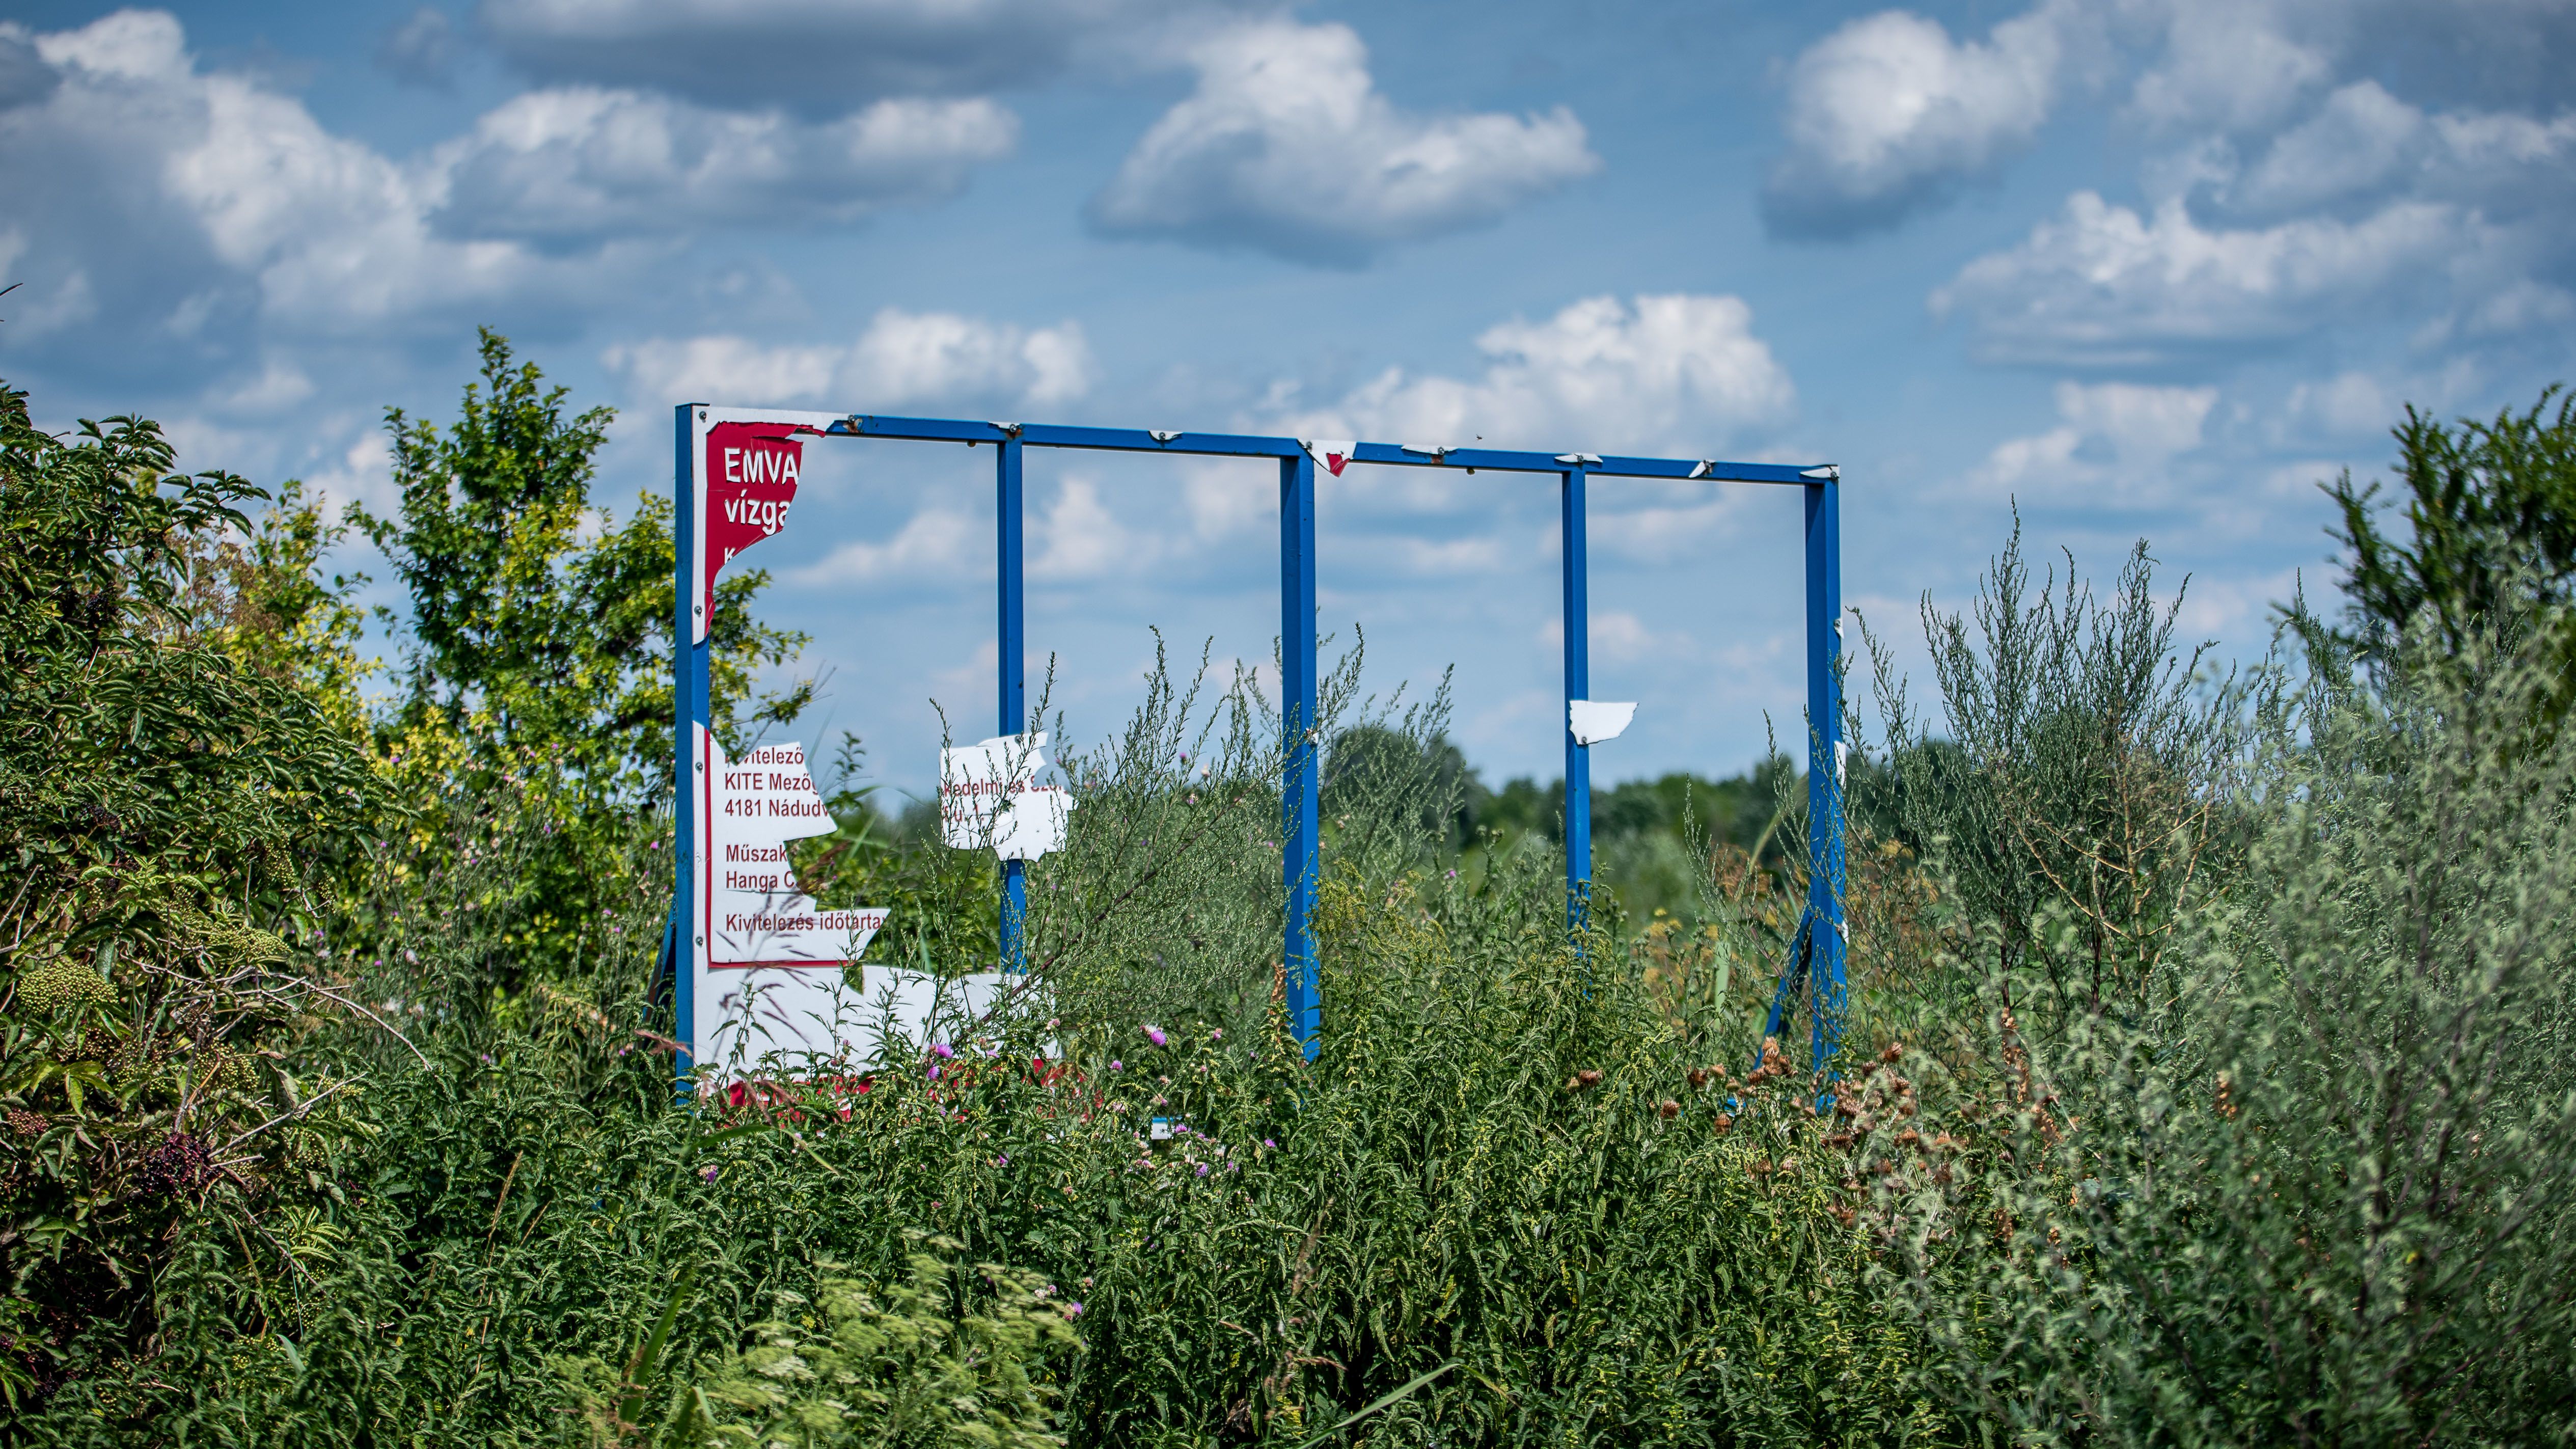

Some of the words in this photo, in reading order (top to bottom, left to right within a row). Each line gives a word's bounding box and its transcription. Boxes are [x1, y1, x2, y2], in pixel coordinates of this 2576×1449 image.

[724, 448, 799, 485] EMVA
[724, 488, 790, 535] vízga
[725, 773, 763, 790] KITE
[725, 799, 762, 817] 4181
[726, 844, 787, 862] Műszak
[726, 871, 778, 893] Hanga
[726, 913, 814, 932] Kivitelezés
[820, 913, 885, 930] időtarta
